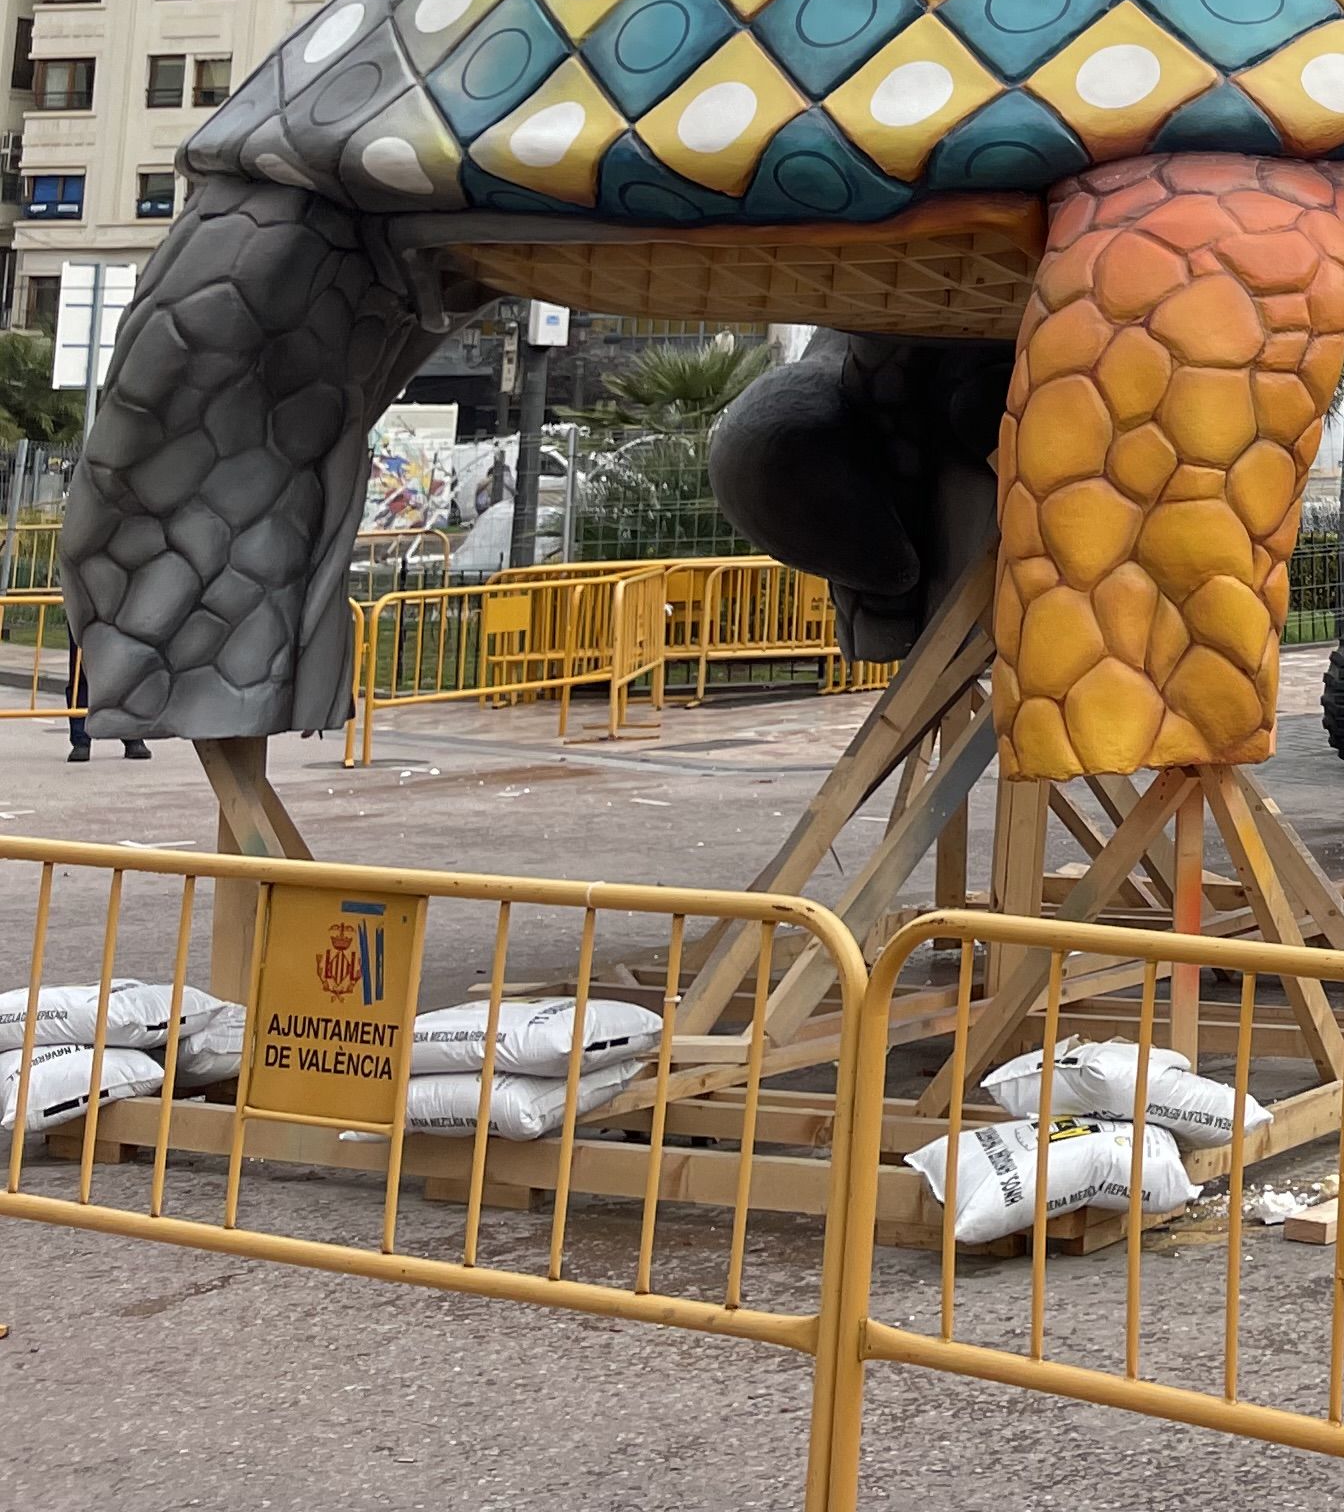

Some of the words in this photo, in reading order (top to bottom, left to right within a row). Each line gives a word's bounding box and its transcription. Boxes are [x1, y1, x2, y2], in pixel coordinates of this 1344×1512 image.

[267, 1013, 399, 1048] AJUNTAMENT
[264, 1044, 292, 1069] DE
[298, 1045, 393, 1080] VALÈNCIA
